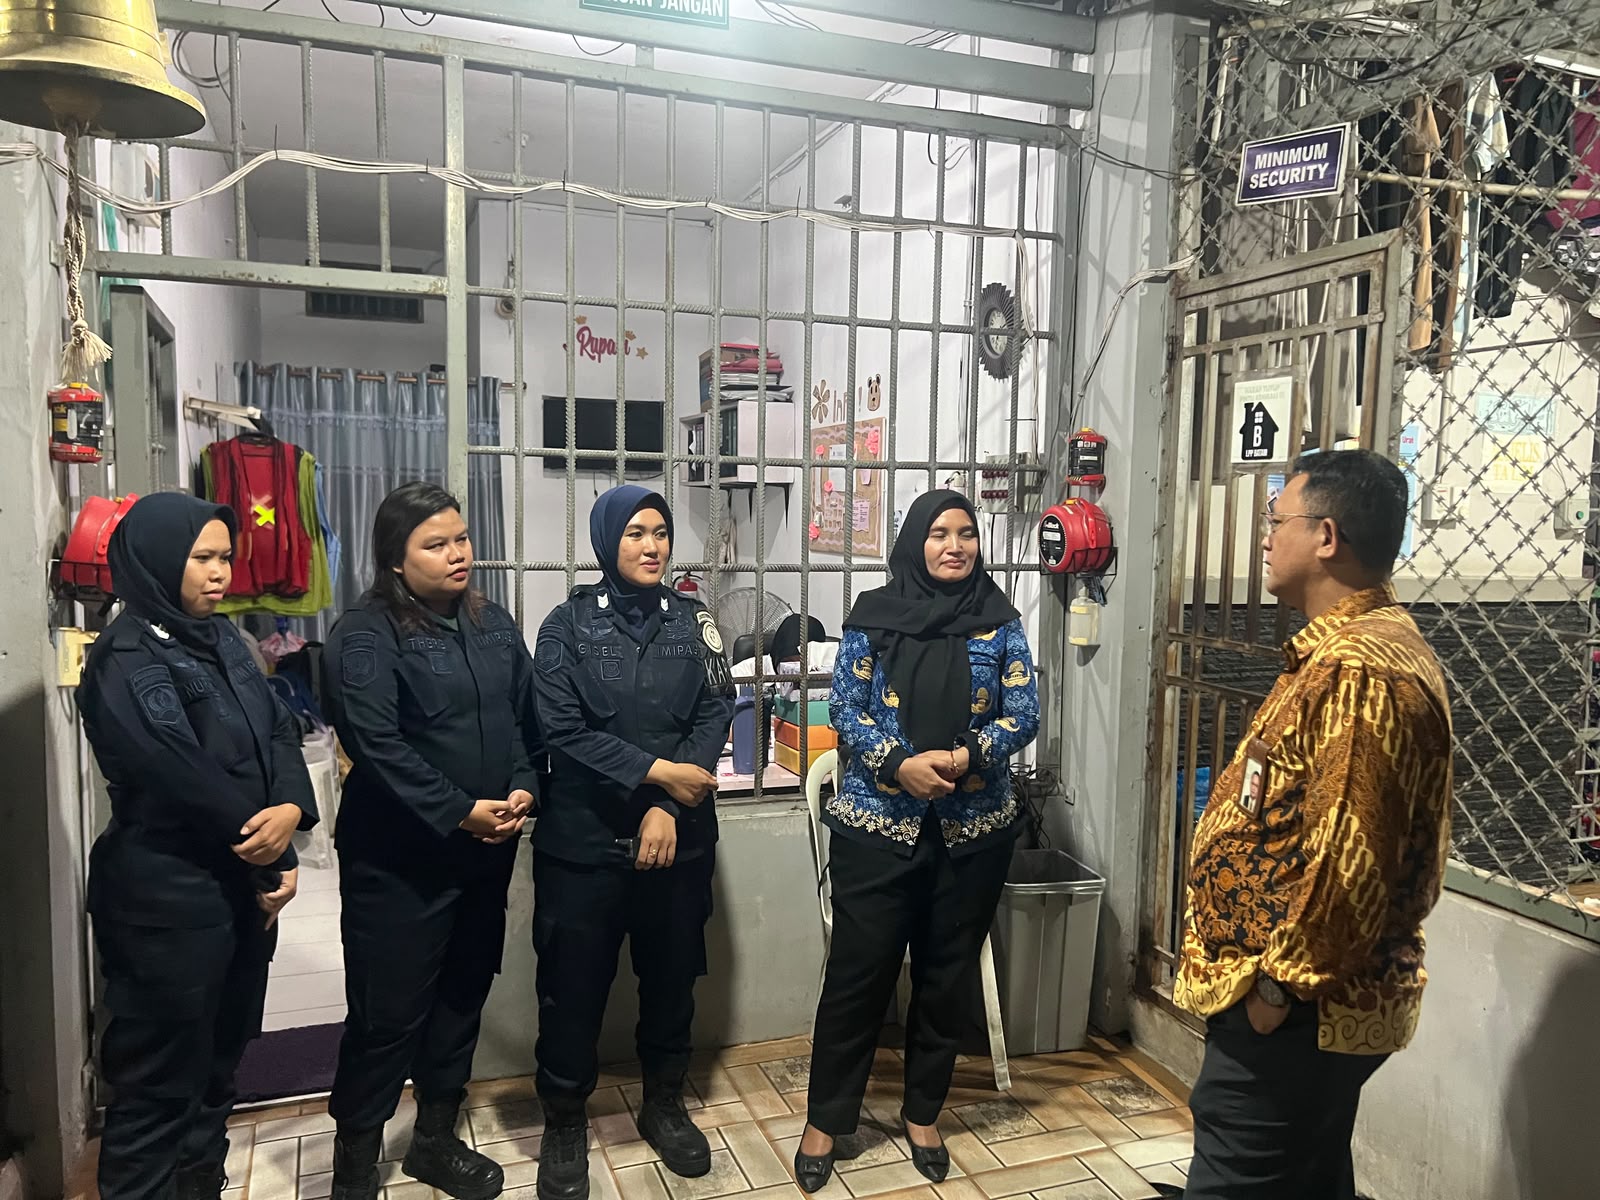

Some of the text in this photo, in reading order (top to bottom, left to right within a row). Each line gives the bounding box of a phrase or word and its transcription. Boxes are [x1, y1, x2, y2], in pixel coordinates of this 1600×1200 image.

[1254, 142, 1328, 170] MINIMUM
[1249, 162, 1330, 190] SECURITY
[1252, 425, 1263, 448] B
